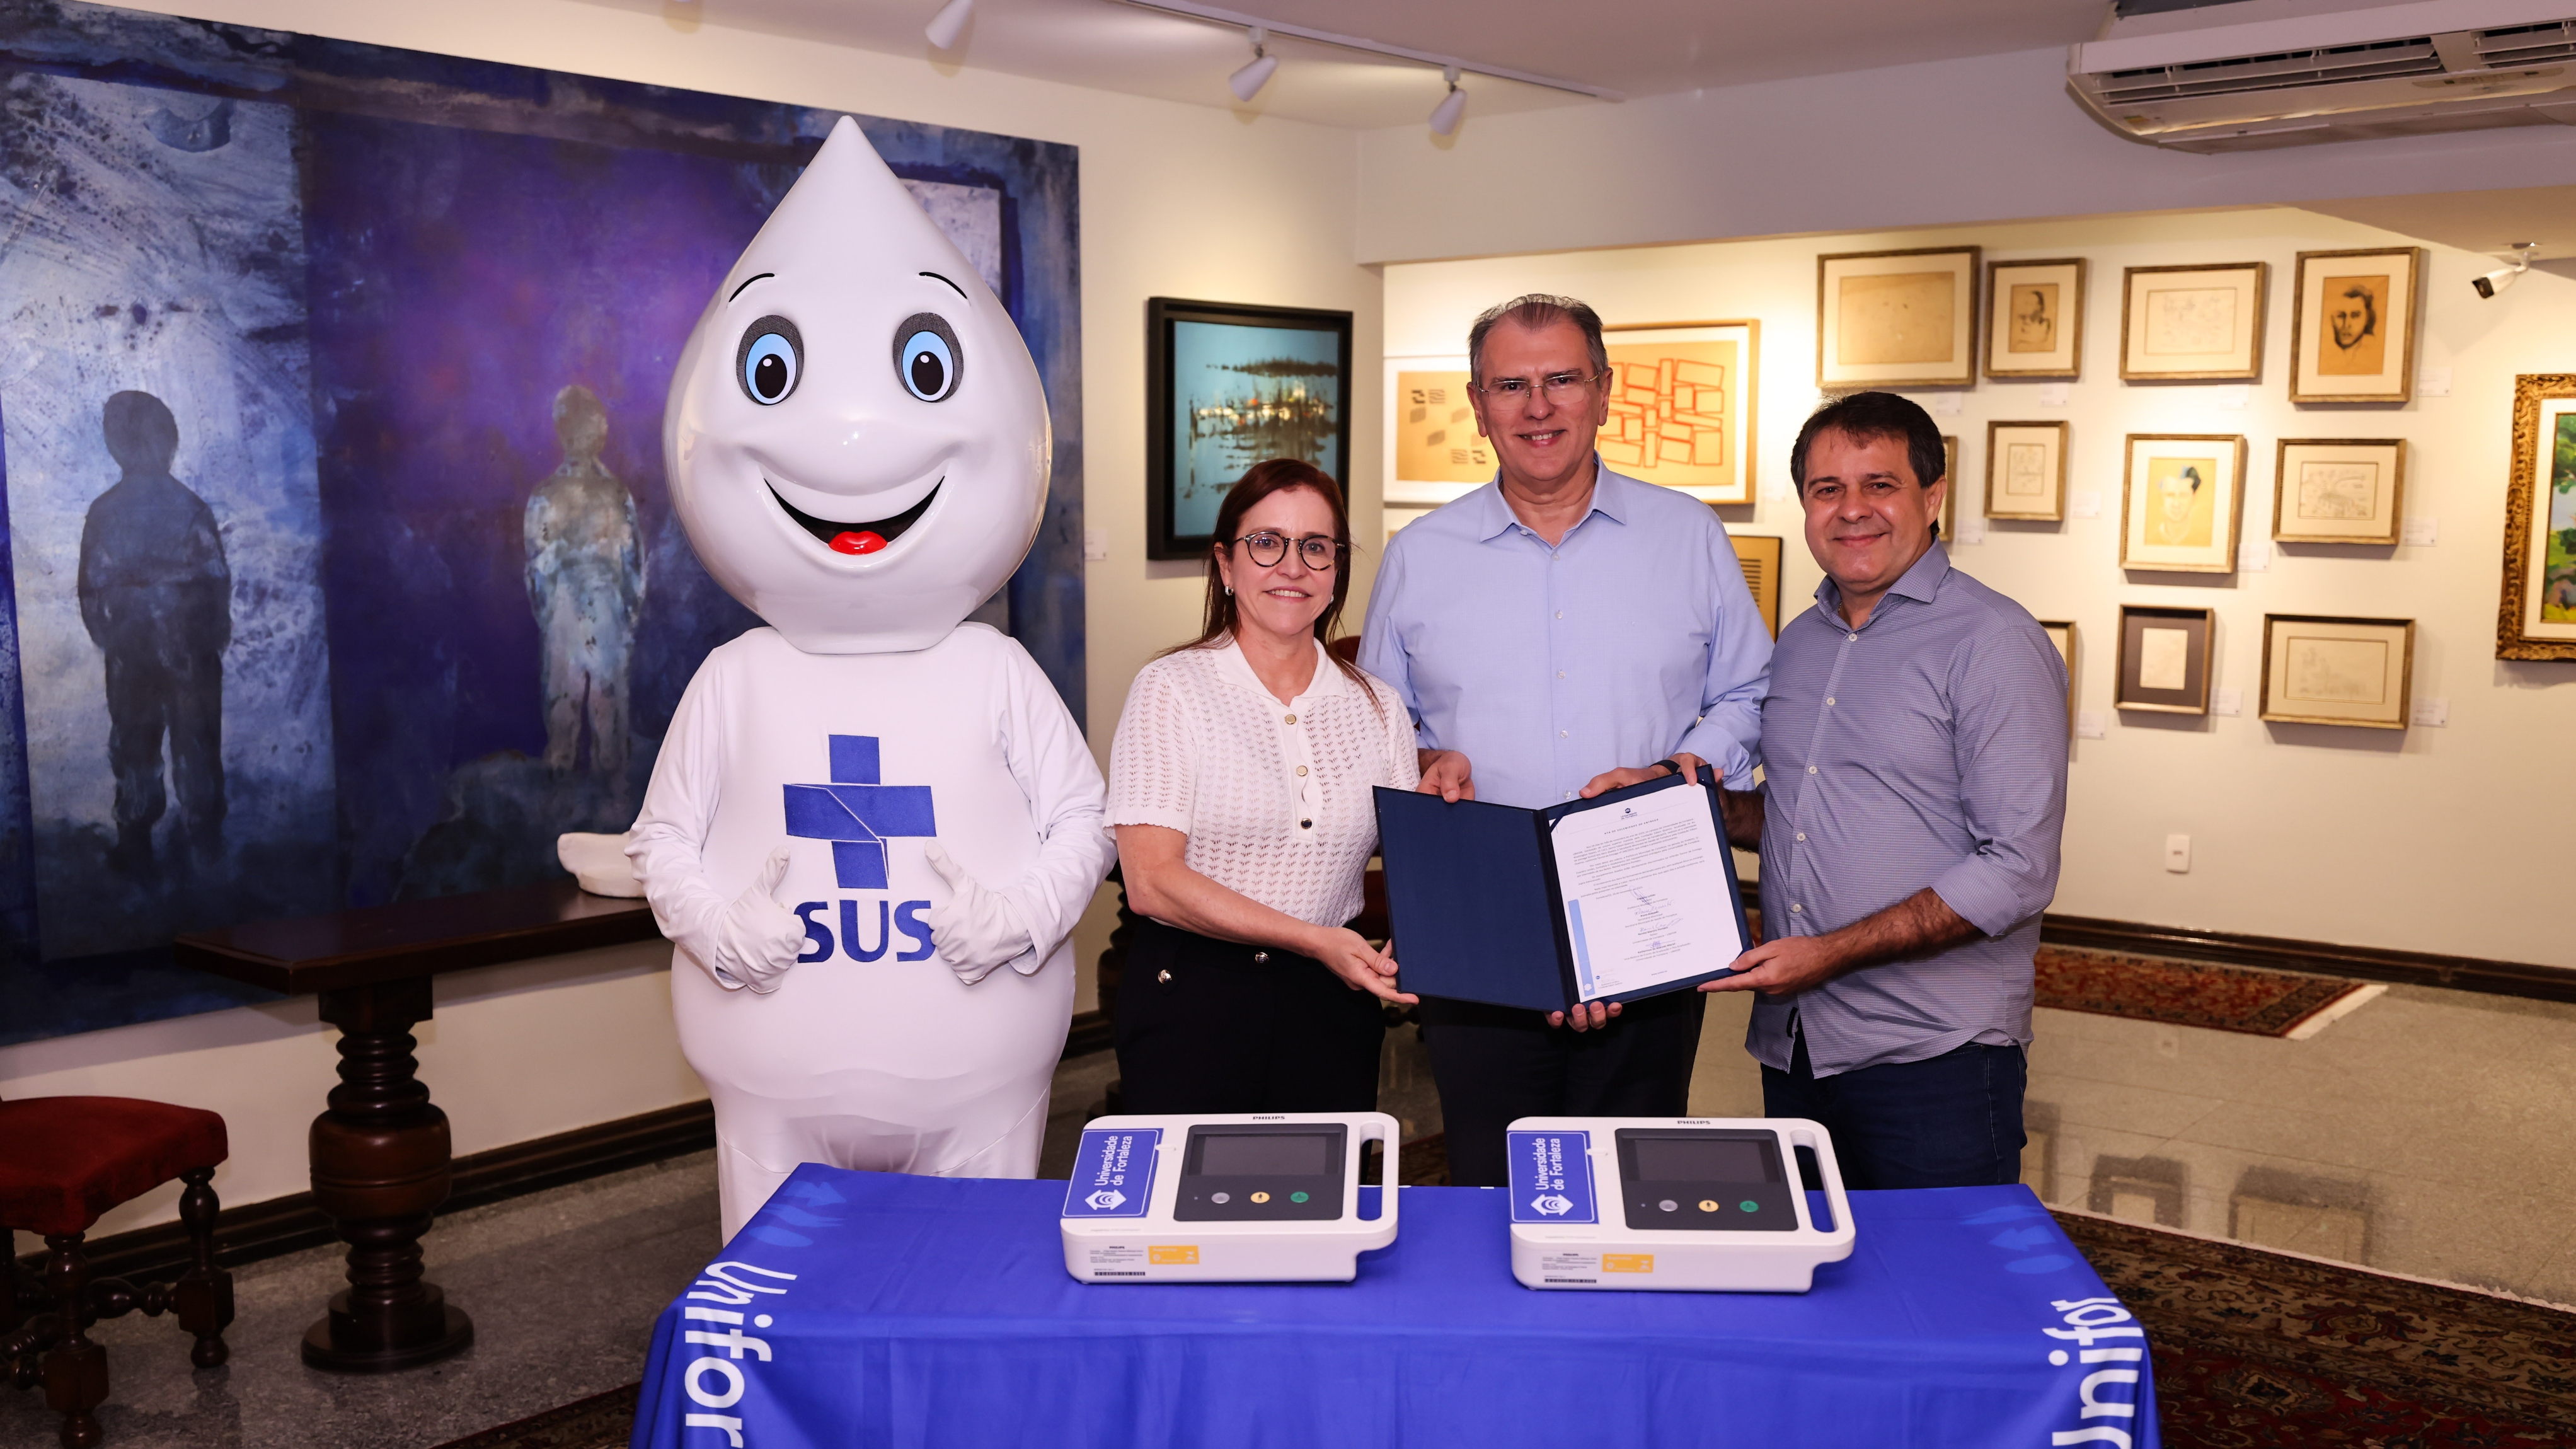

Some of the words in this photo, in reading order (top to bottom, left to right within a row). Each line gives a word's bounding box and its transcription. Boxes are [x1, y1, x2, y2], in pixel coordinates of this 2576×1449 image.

[793, 899, 936, 963] SUS
[1095, 1136, 1118, 1186] Universidade
[1112, 1136, 1132, 1172] Fortaleza
[1532, 1138, 1550, 1190] Universidade
[1547, 1138, 1563, 1175] Fortaleza
[1110, 1175, 1124, 1186] de
[1550, 1179, 1565, 1191] de
[684, 1261, 798, 1448] Unifor
